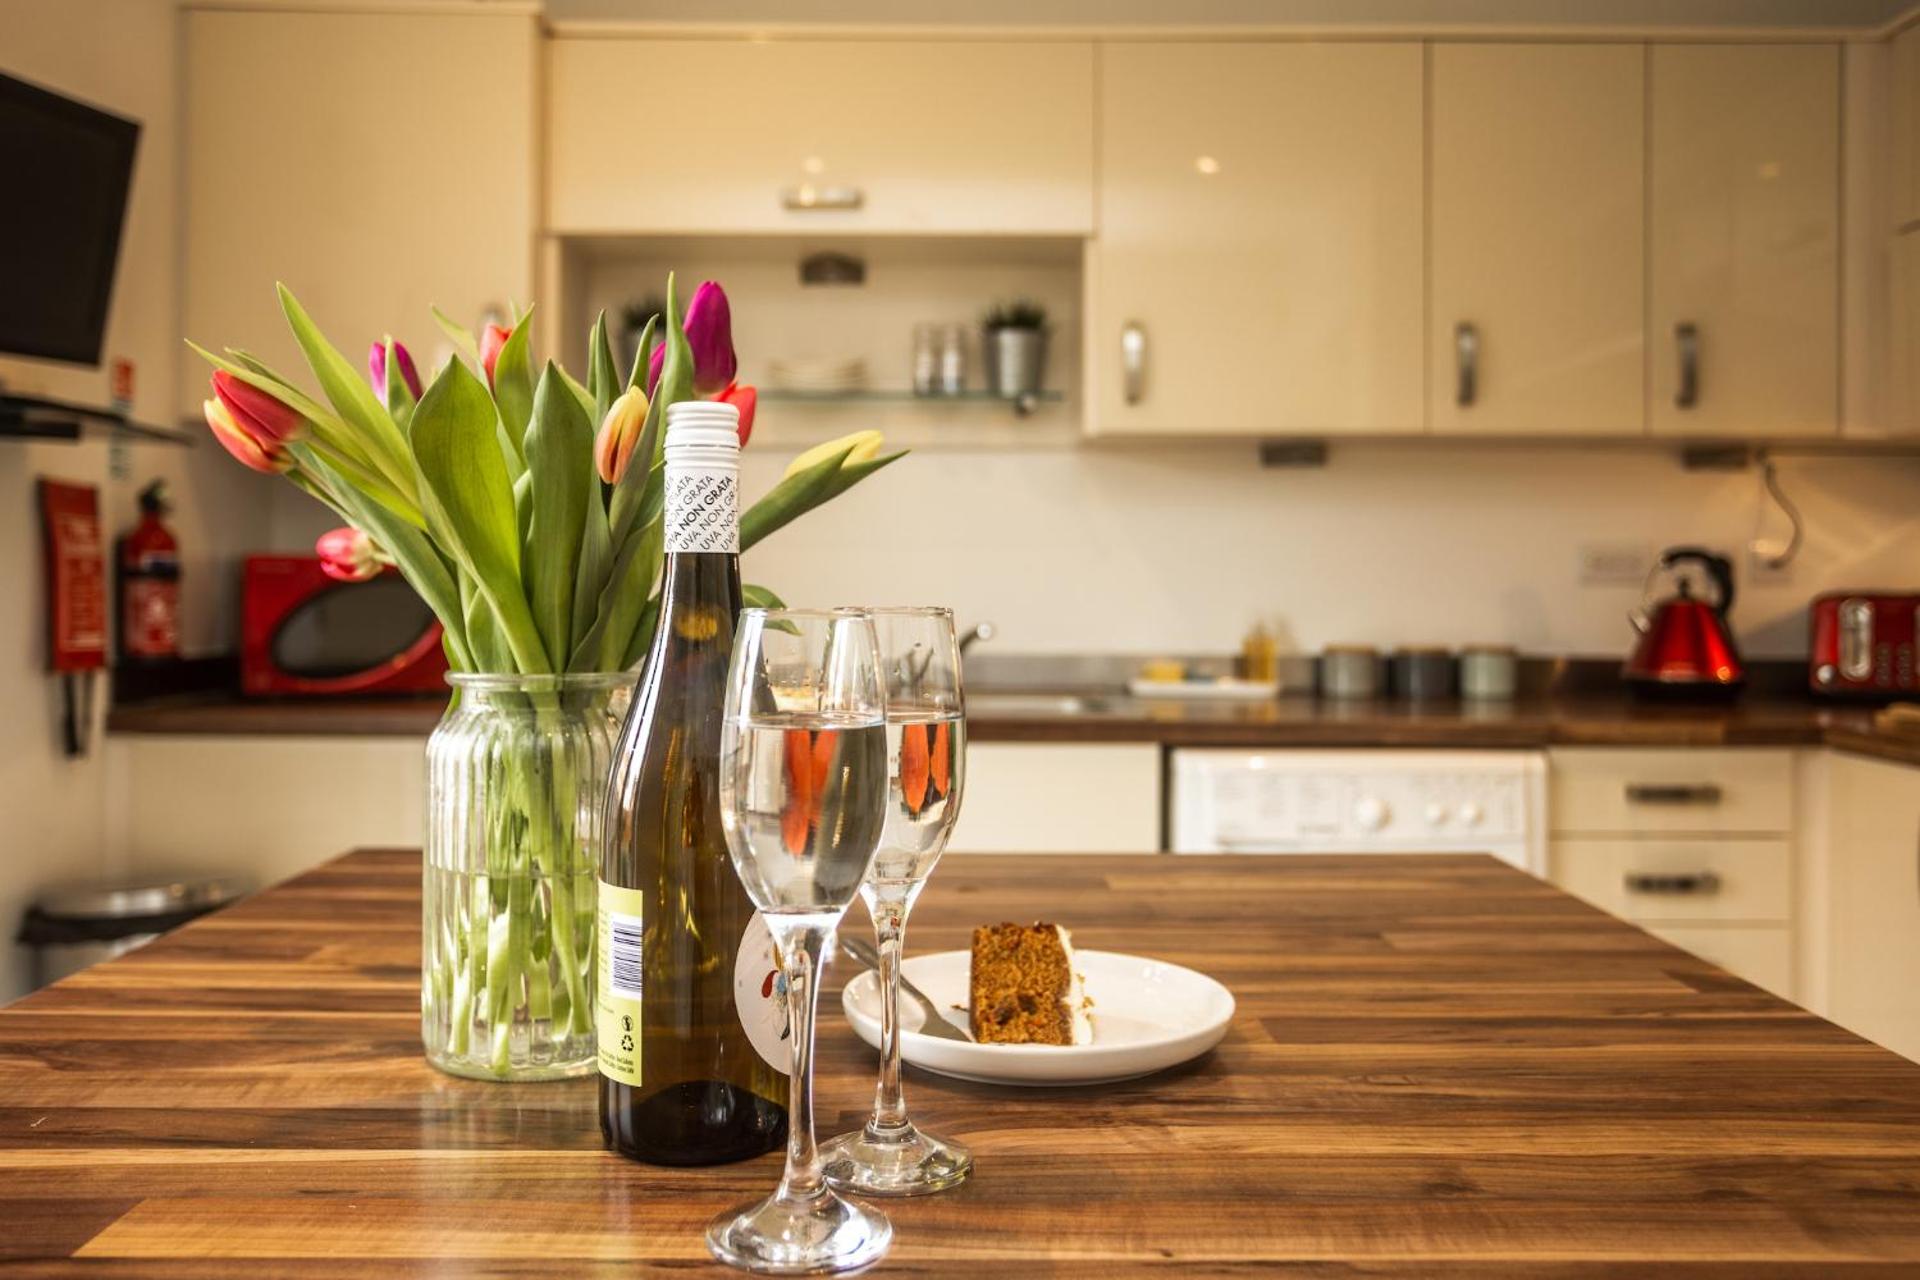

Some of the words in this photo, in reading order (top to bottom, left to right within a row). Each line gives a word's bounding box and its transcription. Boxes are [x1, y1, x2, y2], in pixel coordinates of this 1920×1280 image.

[678, 503, 706, 531] NON
[704, 476, 733, 505] GRATA
[683, 475, 715, 505] GRATA
[680, 531, 702, 550] UVA
[699, 504, 725, 531] NON
[700, 531, 722, 550] UVA
[721, 532, 736, 551] UVA
